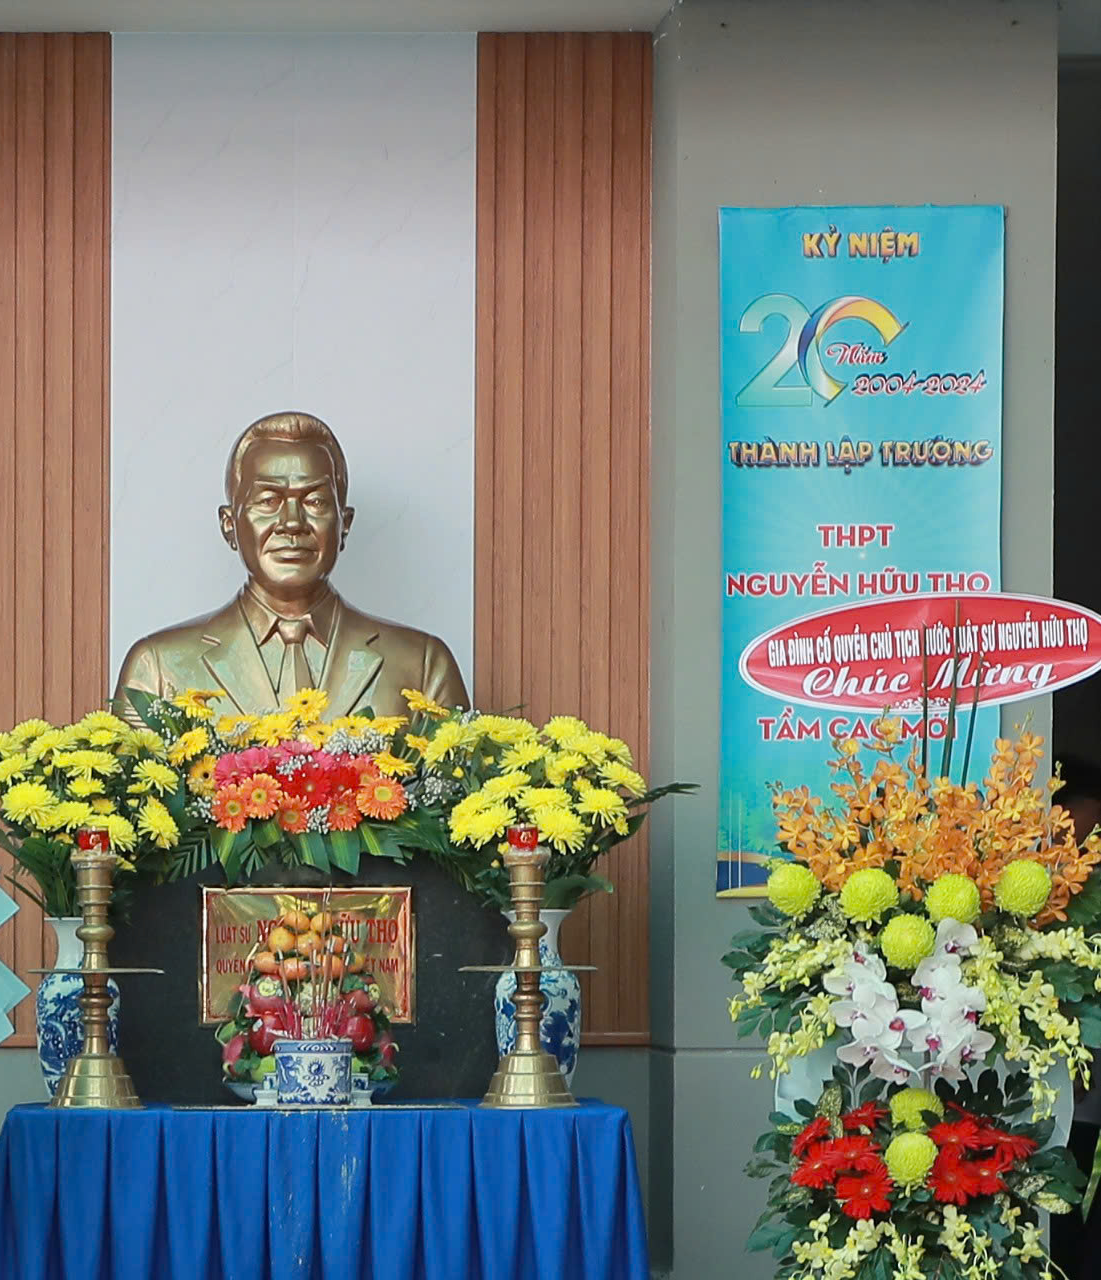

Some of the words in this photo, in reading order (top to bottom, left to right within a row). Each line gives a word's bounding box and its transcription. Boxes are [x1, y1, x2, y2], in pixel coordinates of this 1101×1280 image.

[802, 224, 842, 258] KỶ
[847, 226, 919, 264] NIỆM
[851, 369, 987, 396] 2004-2024
[728, 435, 819, 468] THÀNH
[825, 434, 873, 475] LẬP
[880, 434, 995, 468] TRƯỜNG
[817, 524, 895, 548] THPT
[727, 561, 850, 597] NGUYỄN
[857, 566, 920, 596] HỮU
[768, 639, 787, 668] GIA
[788, 631, 815, 666] ĐÌNH
[816, 625, 832, 664] CỐ
[870, 622, 893, 661] CHỦ
[894, 628, 921, 665] TỊCH
[981, 620, 997, 653] SƯ
[1041, 613, 1064, 648] HỮU
[1066, 617, 1089, 652] THỌ
[802, 664, 912, 699] Chúc
[758, 708, 822, 740] TẦM
[339, 912, 360, 944] ỮU
[366, 918, 398, 950] THỌ
[380, 957, 399, 973] NAM
